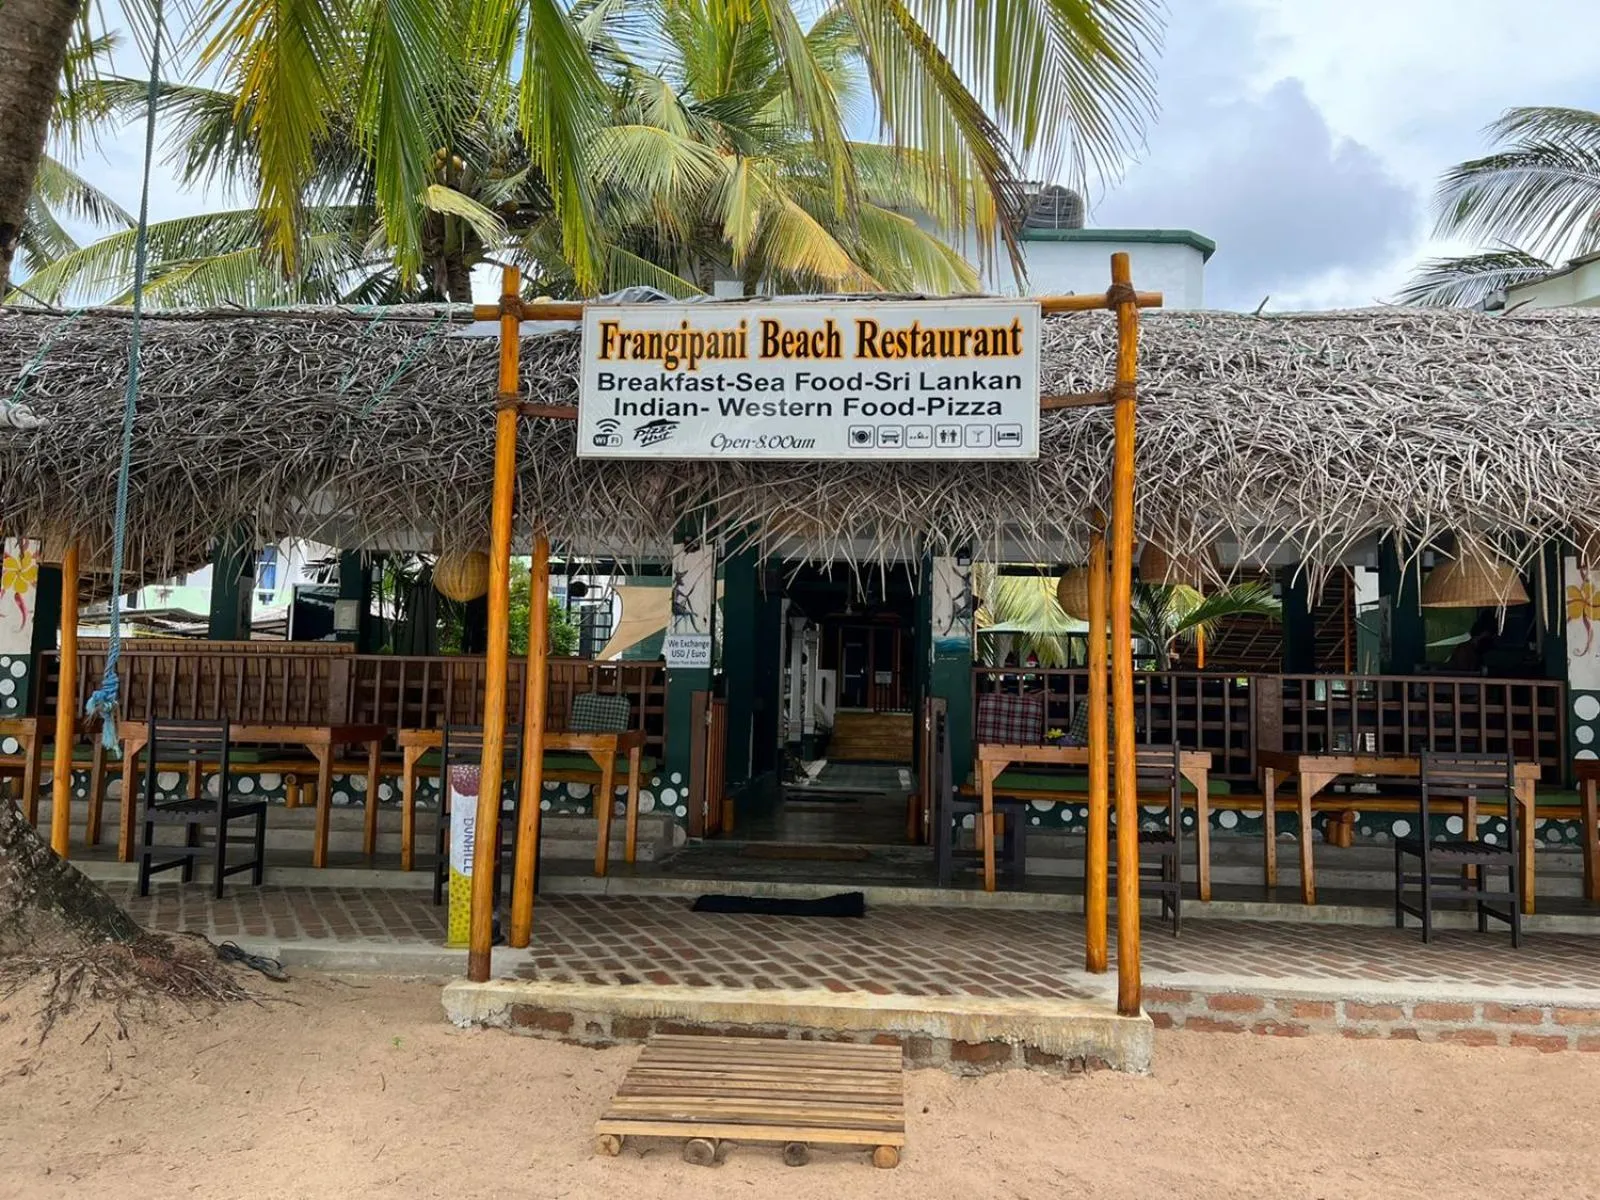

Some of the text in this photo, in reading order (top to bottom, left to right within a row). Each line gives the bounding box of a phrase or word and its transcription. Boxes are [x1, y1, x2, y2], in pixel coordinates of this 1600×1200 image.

[599, 317, 1023, 371] Frangipani Beach Restaurant
[597, 370, 1022, 392] Breakfast-Sea Food-Sri Lankan
[614, 397, 1002, 417] Indian- Western Food-Pizza
[668, 640, 709, 649] We Exchange
[671, 650, 685, 658] USD
[691, 649, 707, 658] Euro
[462, 817, 474, 873] DUNHILL
